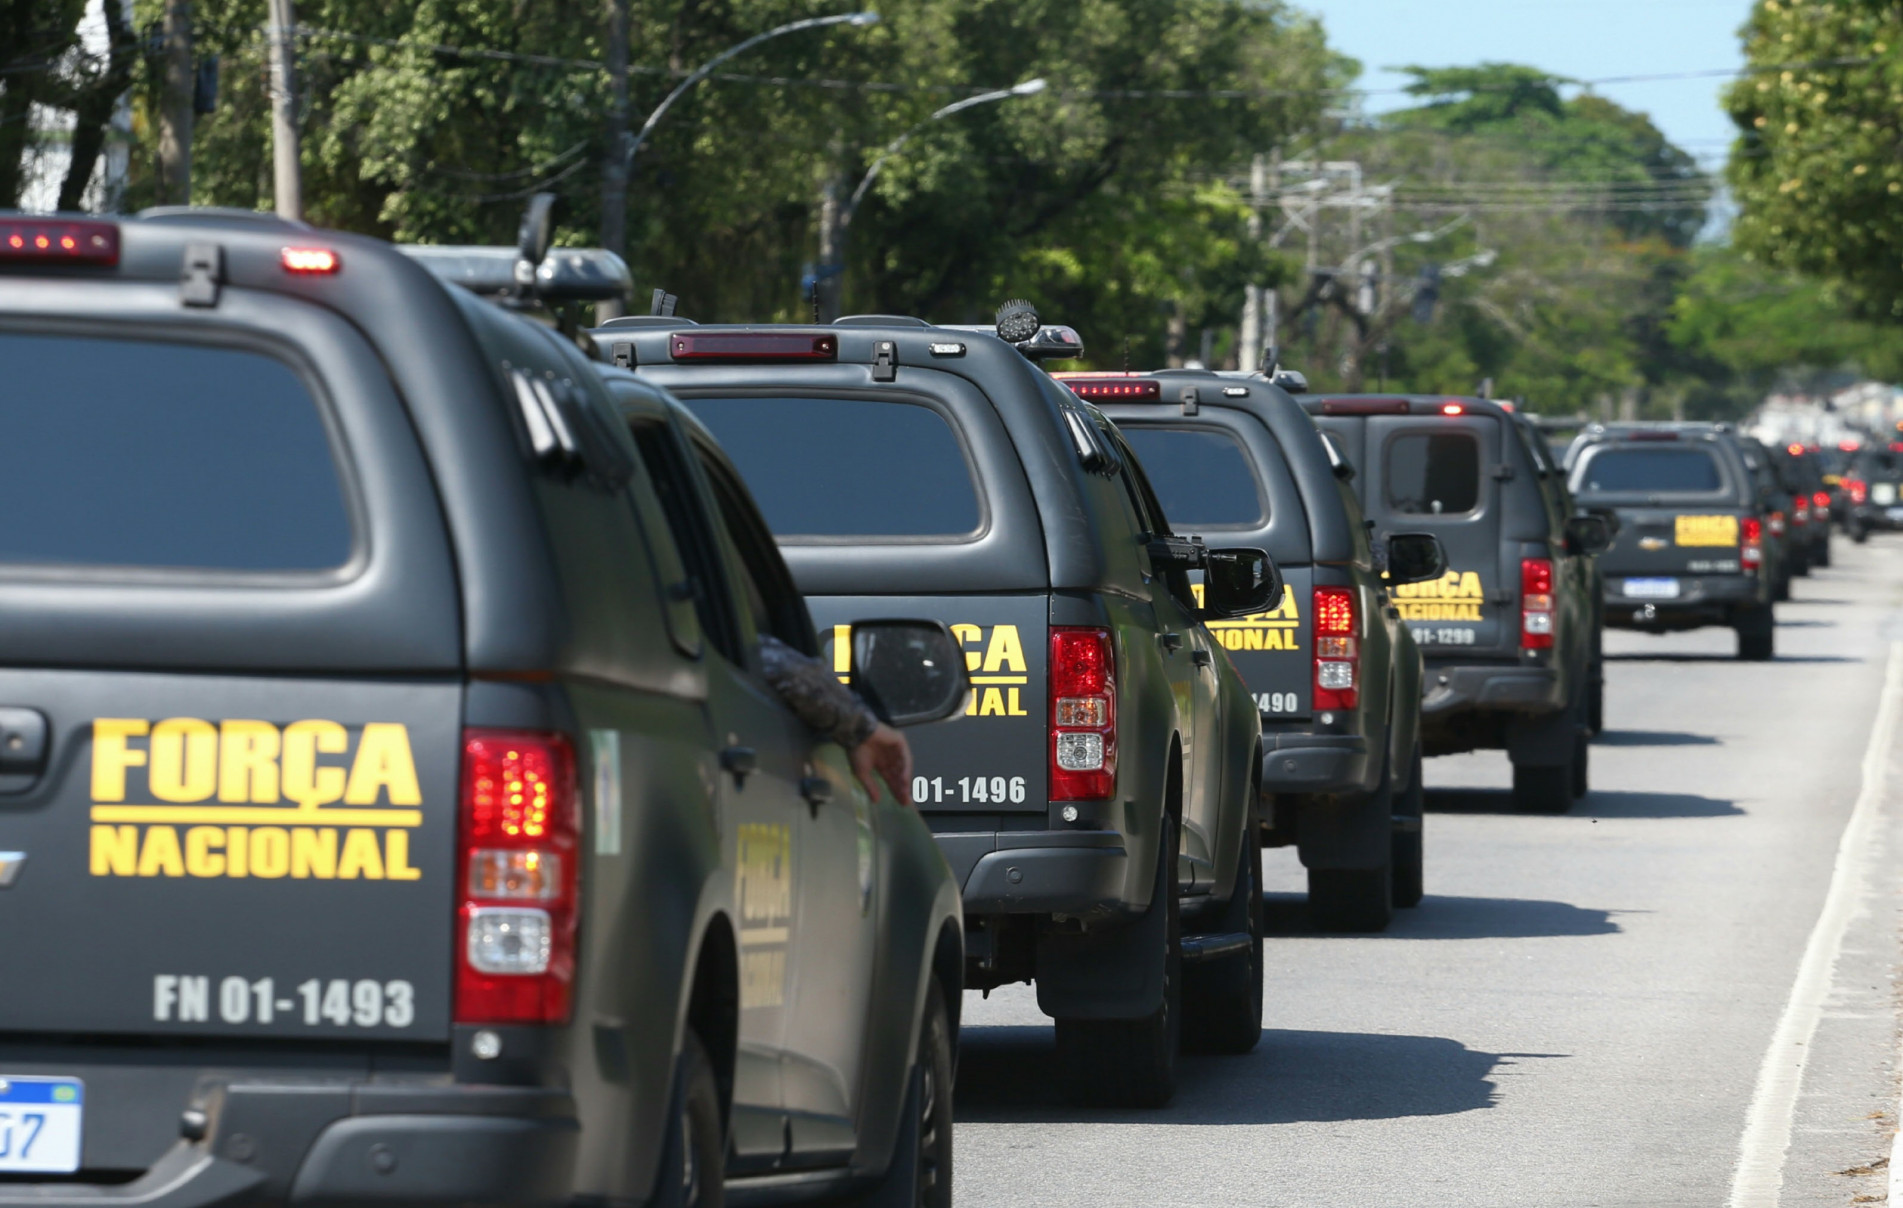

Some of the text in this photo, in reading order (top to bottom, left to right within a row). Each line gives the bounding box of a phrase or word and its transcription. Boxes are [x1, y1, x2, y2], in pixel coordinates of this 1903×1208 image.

[1395, 604, 1484, 621] ACIONAL
[1210, 628, 1299, 651] IONAL
[91, 716, 422, 808] FORÇA
[912, 776, 1026, 804] 01-1496
[90, 825, 422, 881] NACIONAL
[154, 974, 415, 1027] FN 01-1493
